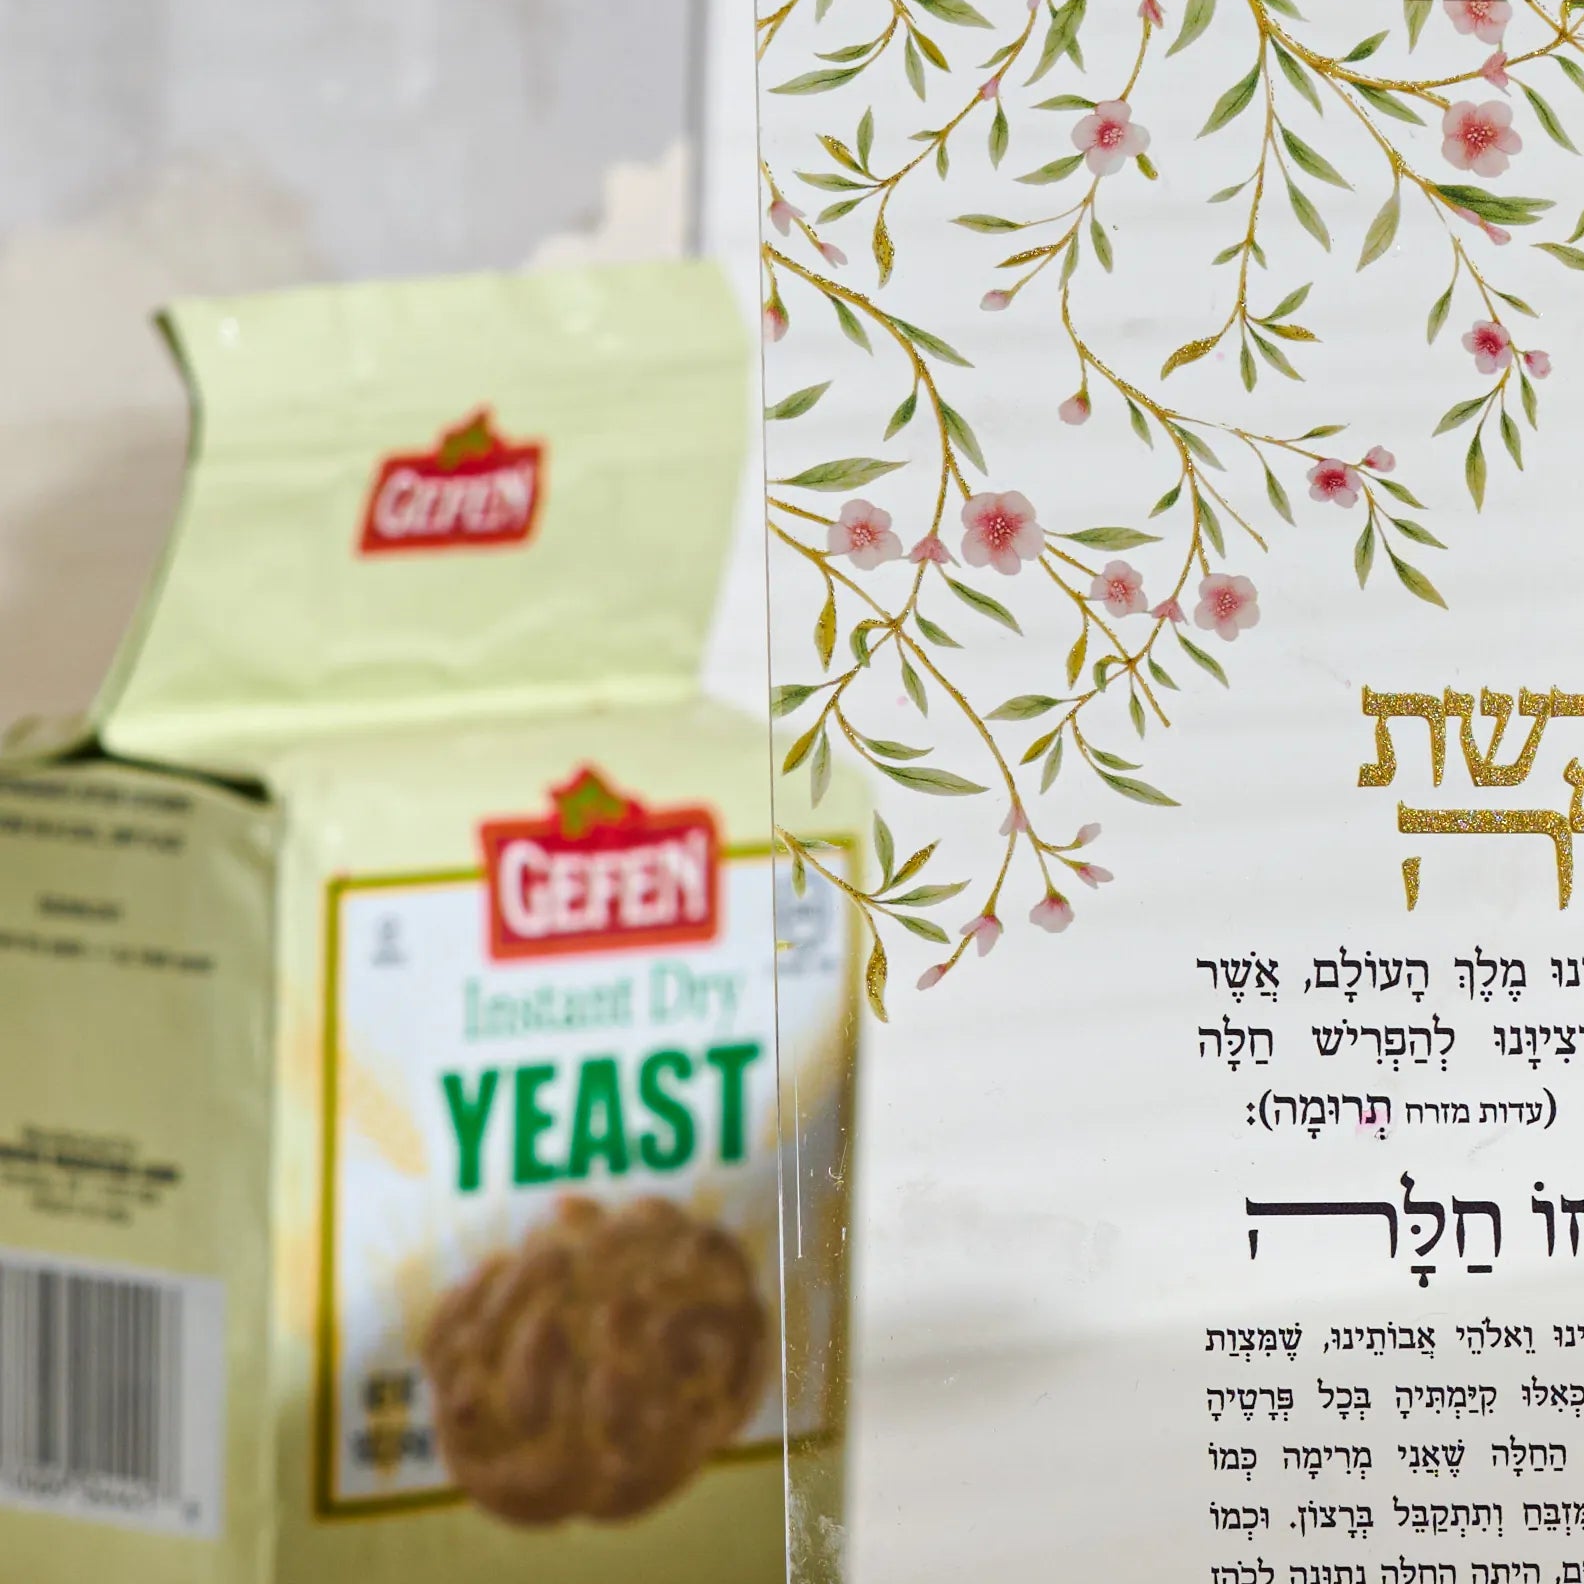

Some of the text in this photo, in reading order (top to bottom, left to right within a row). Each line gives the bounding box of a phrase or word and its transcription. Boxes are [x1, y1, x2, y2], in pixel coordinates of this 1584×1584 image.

[499, 828, 709, 939] GEFEN
[464, 958, 742, 1043] Instant Dry
[440, 1038, 762, 1193] YEAST
[1405, 1101, 1471, 1125] מזרח
[1478, 1087, 1557, 1130] (עדות
[1245, 1170, 1502, 1289] חַלָּה
